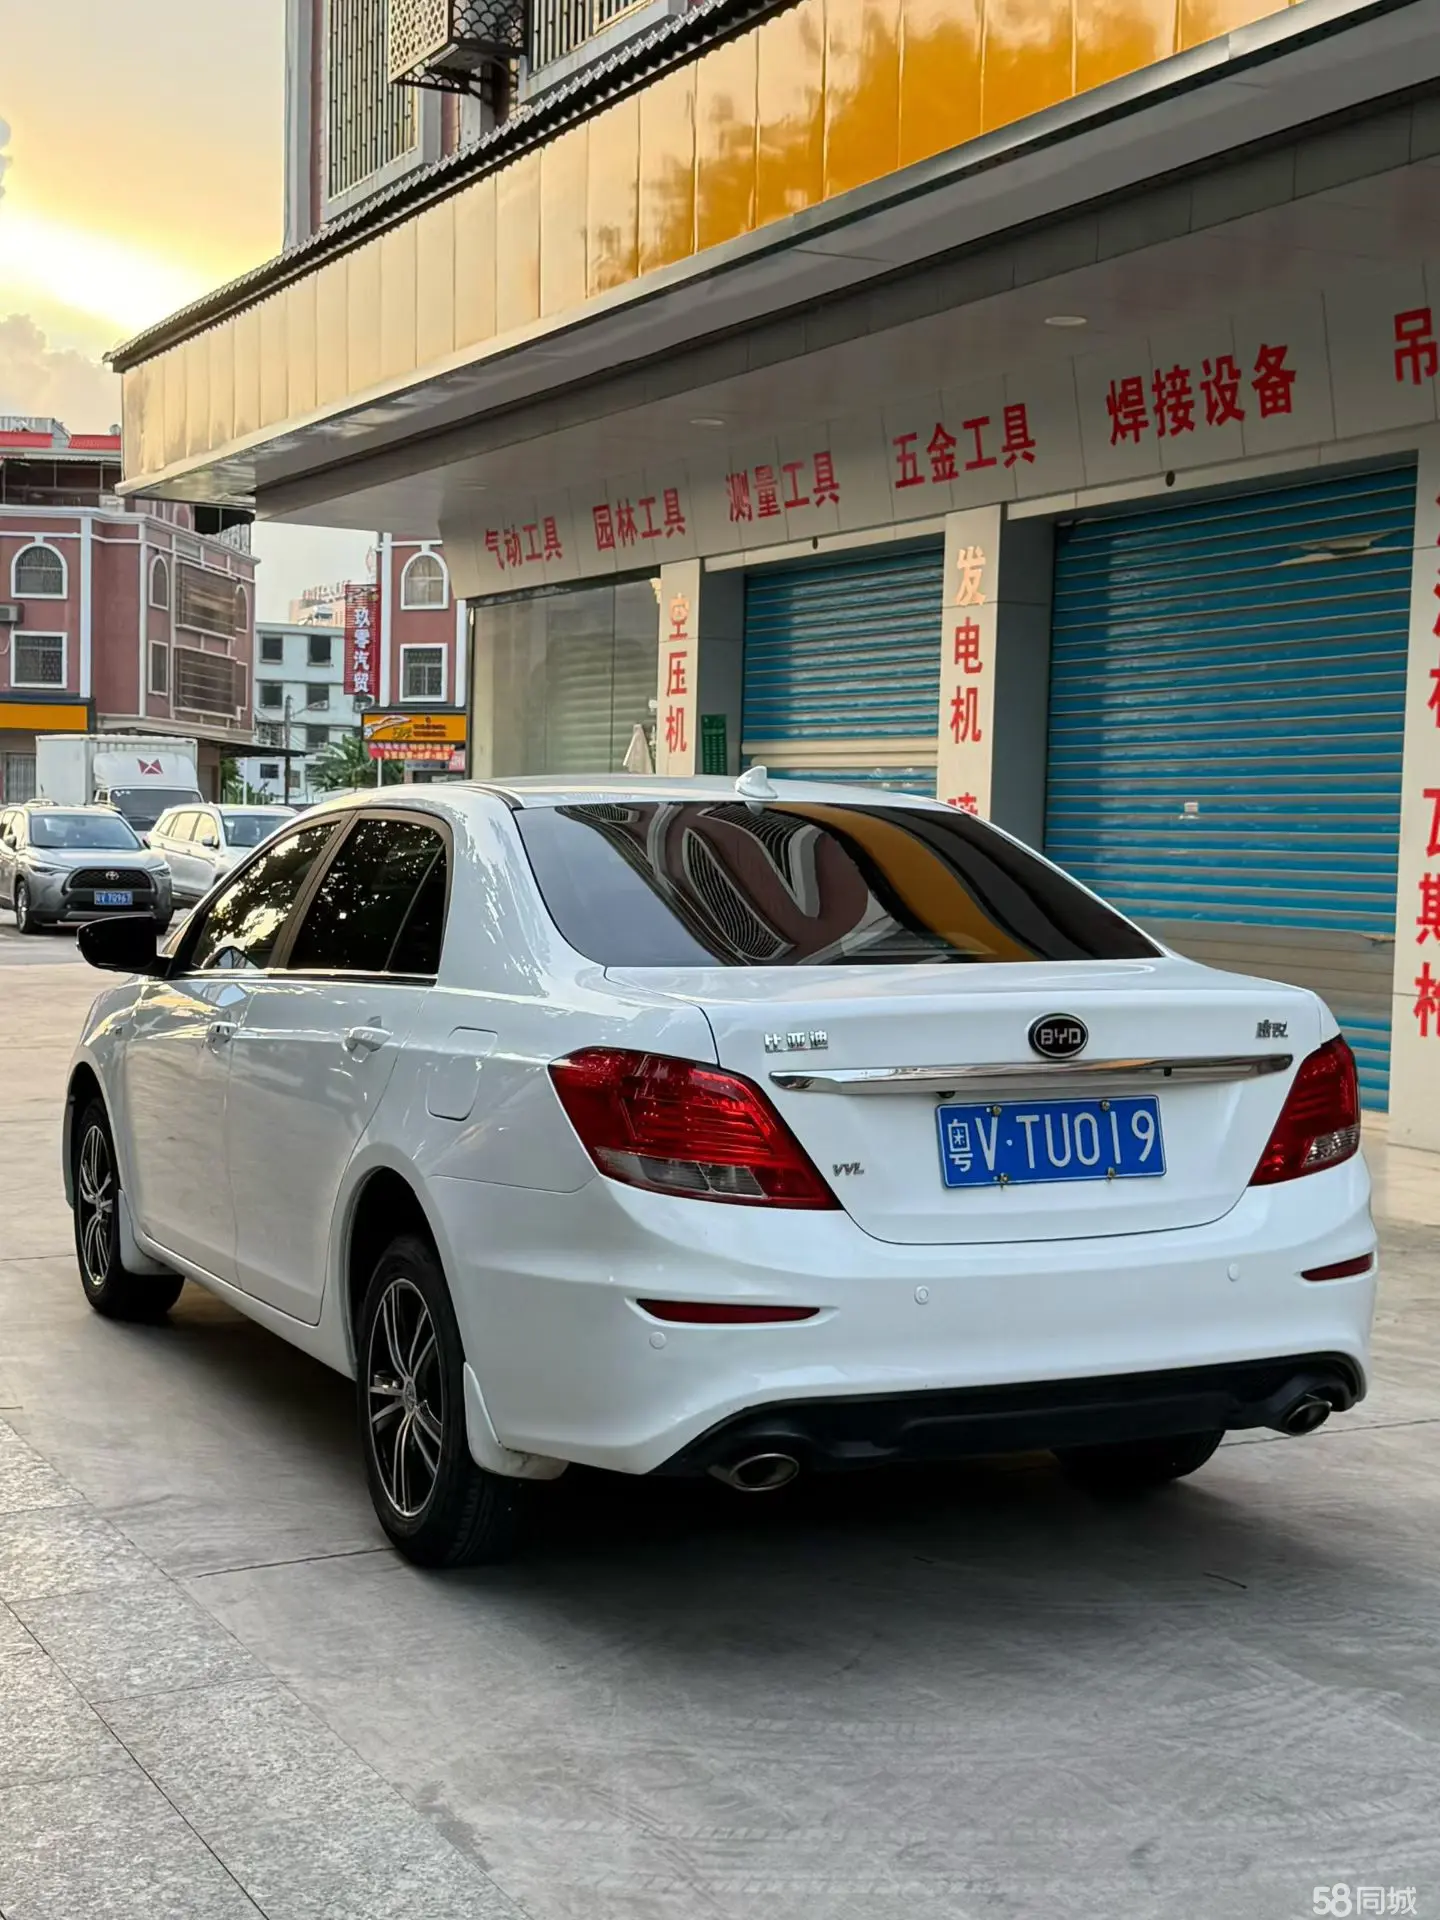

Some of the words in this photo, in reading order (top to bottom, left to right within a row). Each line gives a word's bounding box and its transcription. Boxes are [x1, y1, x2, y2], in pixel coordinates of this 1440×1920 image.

[1394, 308, 1438, 386] 吊
[1106, 344, 1296, 446] 焊接设备
[893, 403, 1037, 490] 五金工具
[593, 488, 686, 551] 园林工具
[726, 451, 840, 522] 测量工具
[484, 516, 562, 571] 气动工具
[665, 594, 689, 753] 空压机
[949, 546, 987, 745] 发电机
[764, 1030, 828, 1053] 比亚迪
[1041, 1028, 1081, 1045] BYD
